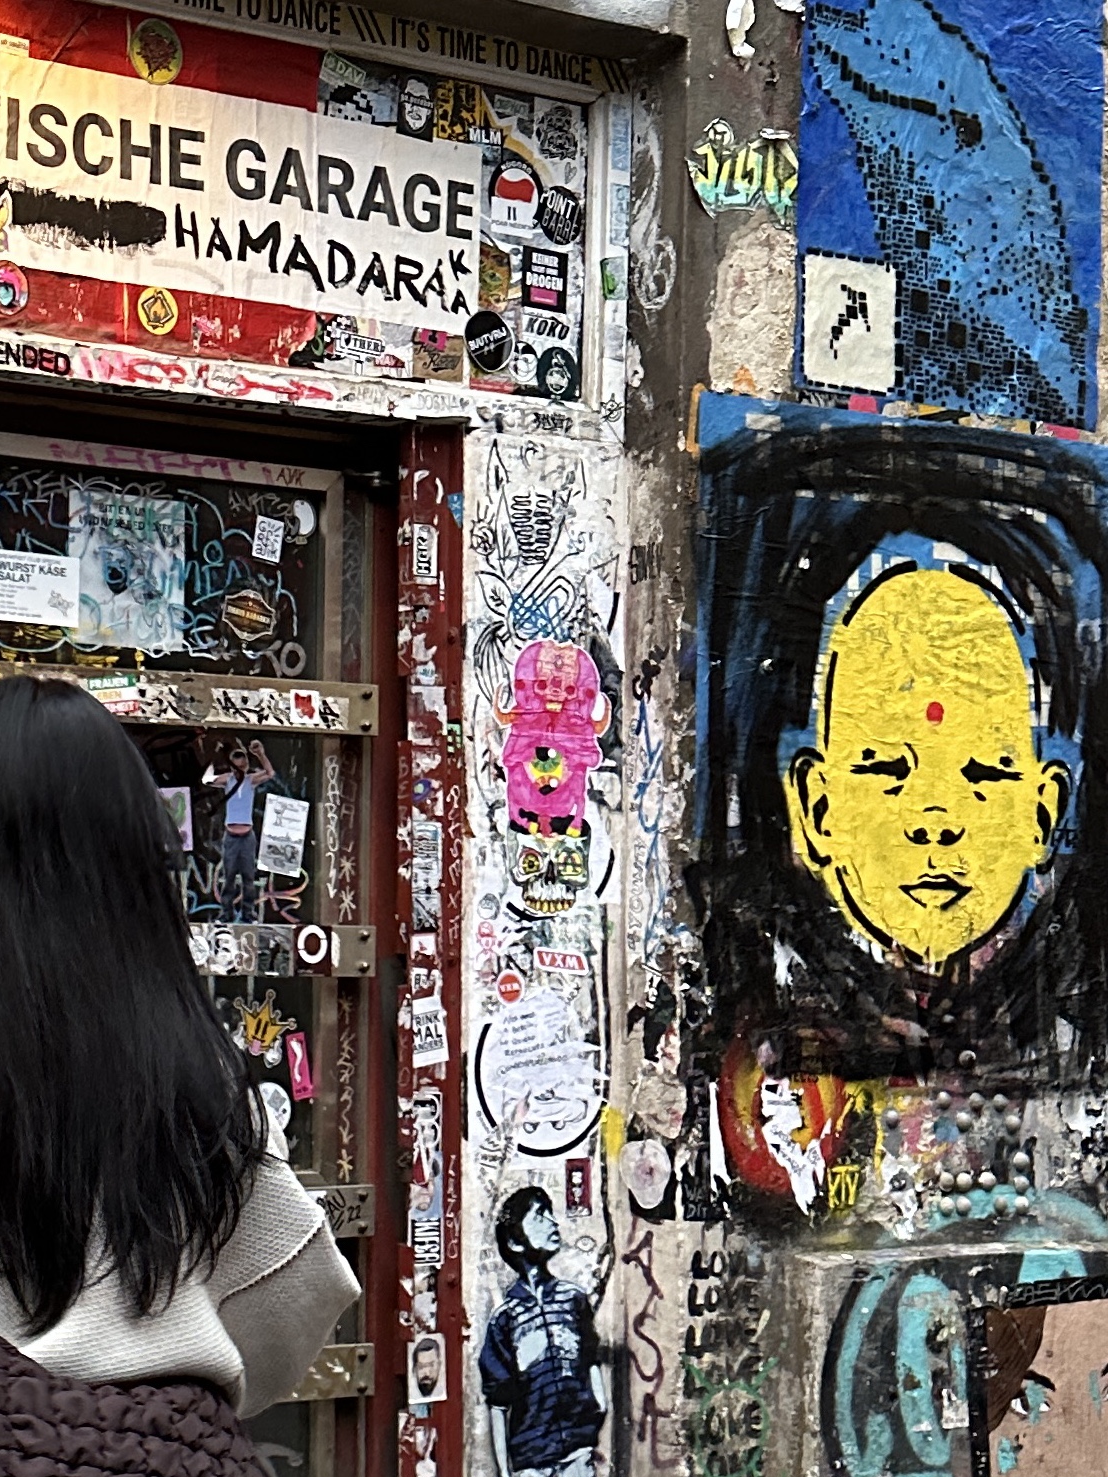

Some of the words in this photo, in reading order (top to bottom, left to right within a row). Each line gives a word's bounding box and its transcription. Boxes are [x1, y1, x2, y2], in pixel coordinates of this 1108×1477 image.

[391, 16, 430, 53] IT'S
[436, 26, 488, 65] TIME
[493, 39, 520, 72] TO
[526, 45, 592, 85] DANCE
[225, 138, 476, 241] GARAGE
[540, 190, 577, 220] POINT
[525, 271, 564, 292] DROGEN
[541, 951, 580, 971] VXM
[412, 1011, 441, 1028] RINK
[412, 1023, 444, 1043] MAL
